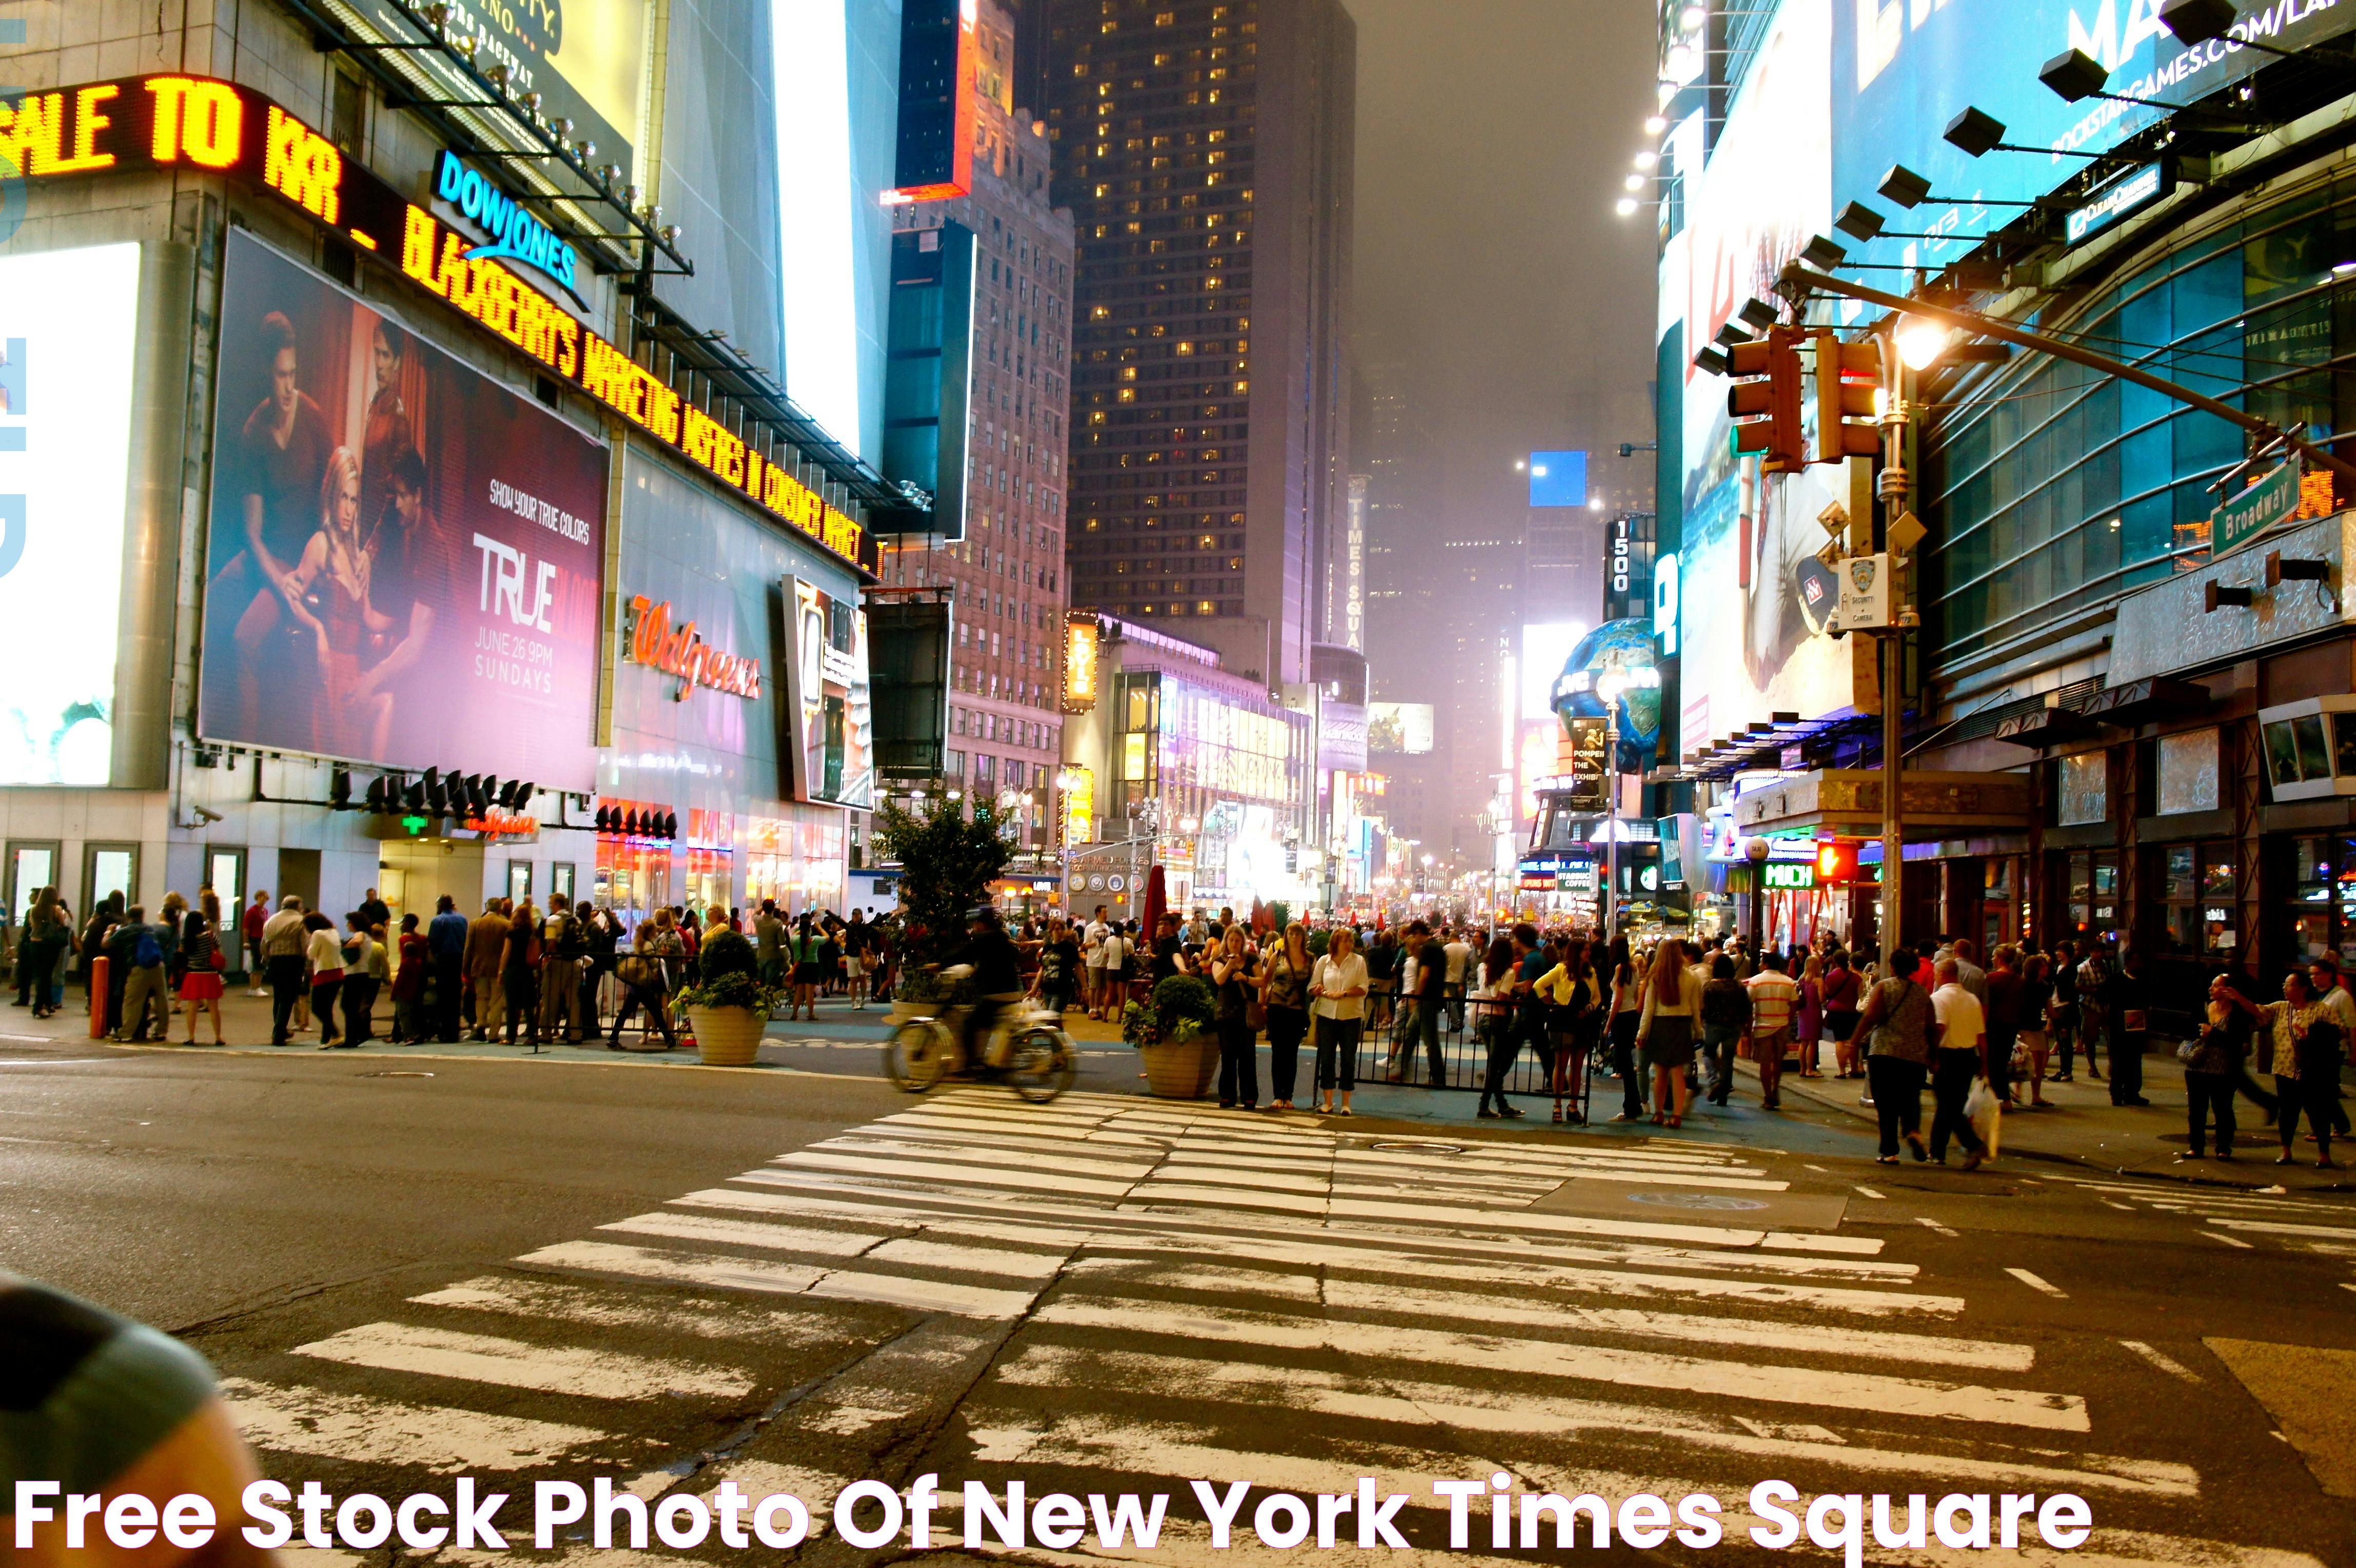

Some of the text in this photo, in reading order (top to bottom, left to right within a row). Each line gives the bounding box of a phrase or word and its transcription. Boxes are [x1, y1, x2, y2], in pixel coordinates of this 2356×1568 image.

[479, 24, 534, 89] RACEWAY
[2051, 0, 2338, 165] ROCKSTARGAMES.COM/LA
[144, 76, 242, 168] TO
[439, 150, 576, 290] DOW JONES
[489, 478, 590, 545] SHOW YOUR TRUE COLORS
[2225, 481, 2288, 540] Broadway
[473, 532, 556, 635] TRUE
[1346, 498, 1363, 649] TIMES SQUA
[1613, 520, 1628, 592] 1500
[1852, 596, 1874, 605] SECURITY
[475, 626, 553, 668] JUNE 26 9PM
[475, 654, 552, 694] SUNDAYS
[633, 594, 762, 701] Walgreens
[1322, 728, 1367, 742] Hankoo
[1558, 872, 1590, 880] STARBUC
[1765, 864, 1813, 887] MUCH
